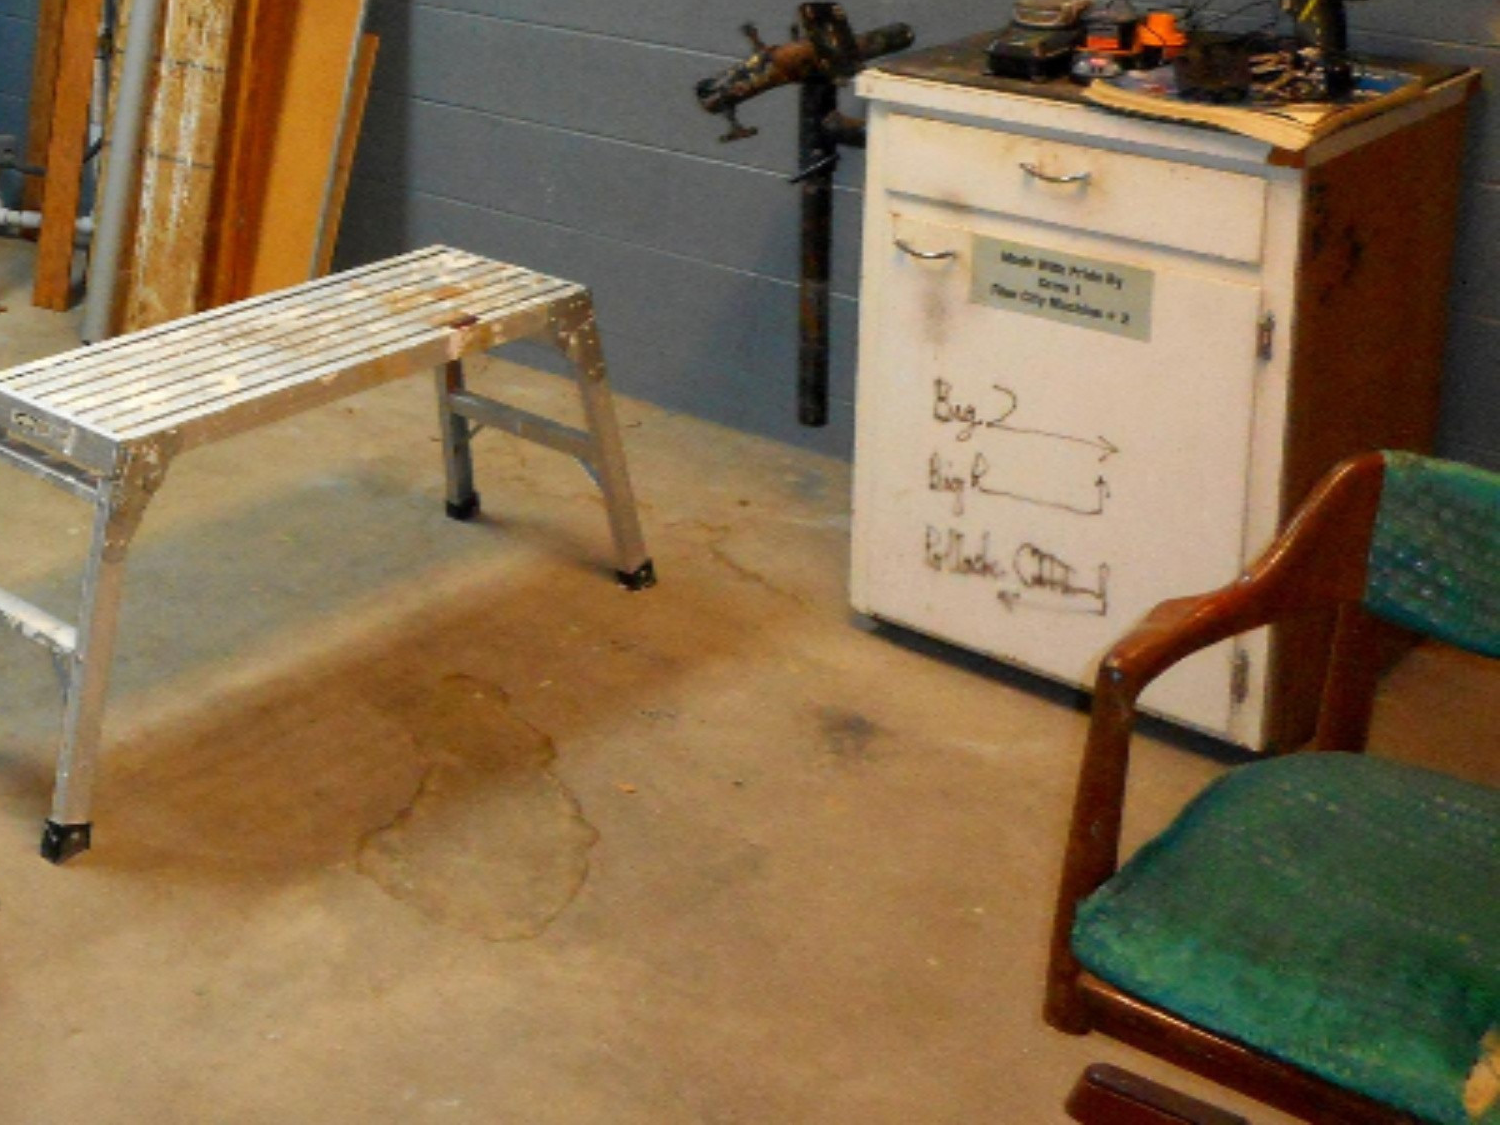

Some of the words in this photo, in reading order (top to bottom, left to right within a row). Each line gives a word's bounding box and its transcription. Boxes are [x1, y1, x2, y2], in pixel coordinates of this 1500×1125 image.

[1001, 251, 1035, 268] Made
[1037, 259, 1066, 275] With
[1069, 266, 1103, 282] Pride
[1105, 272, 1123, 290] By
[1019, 290, 1047, 308] City
